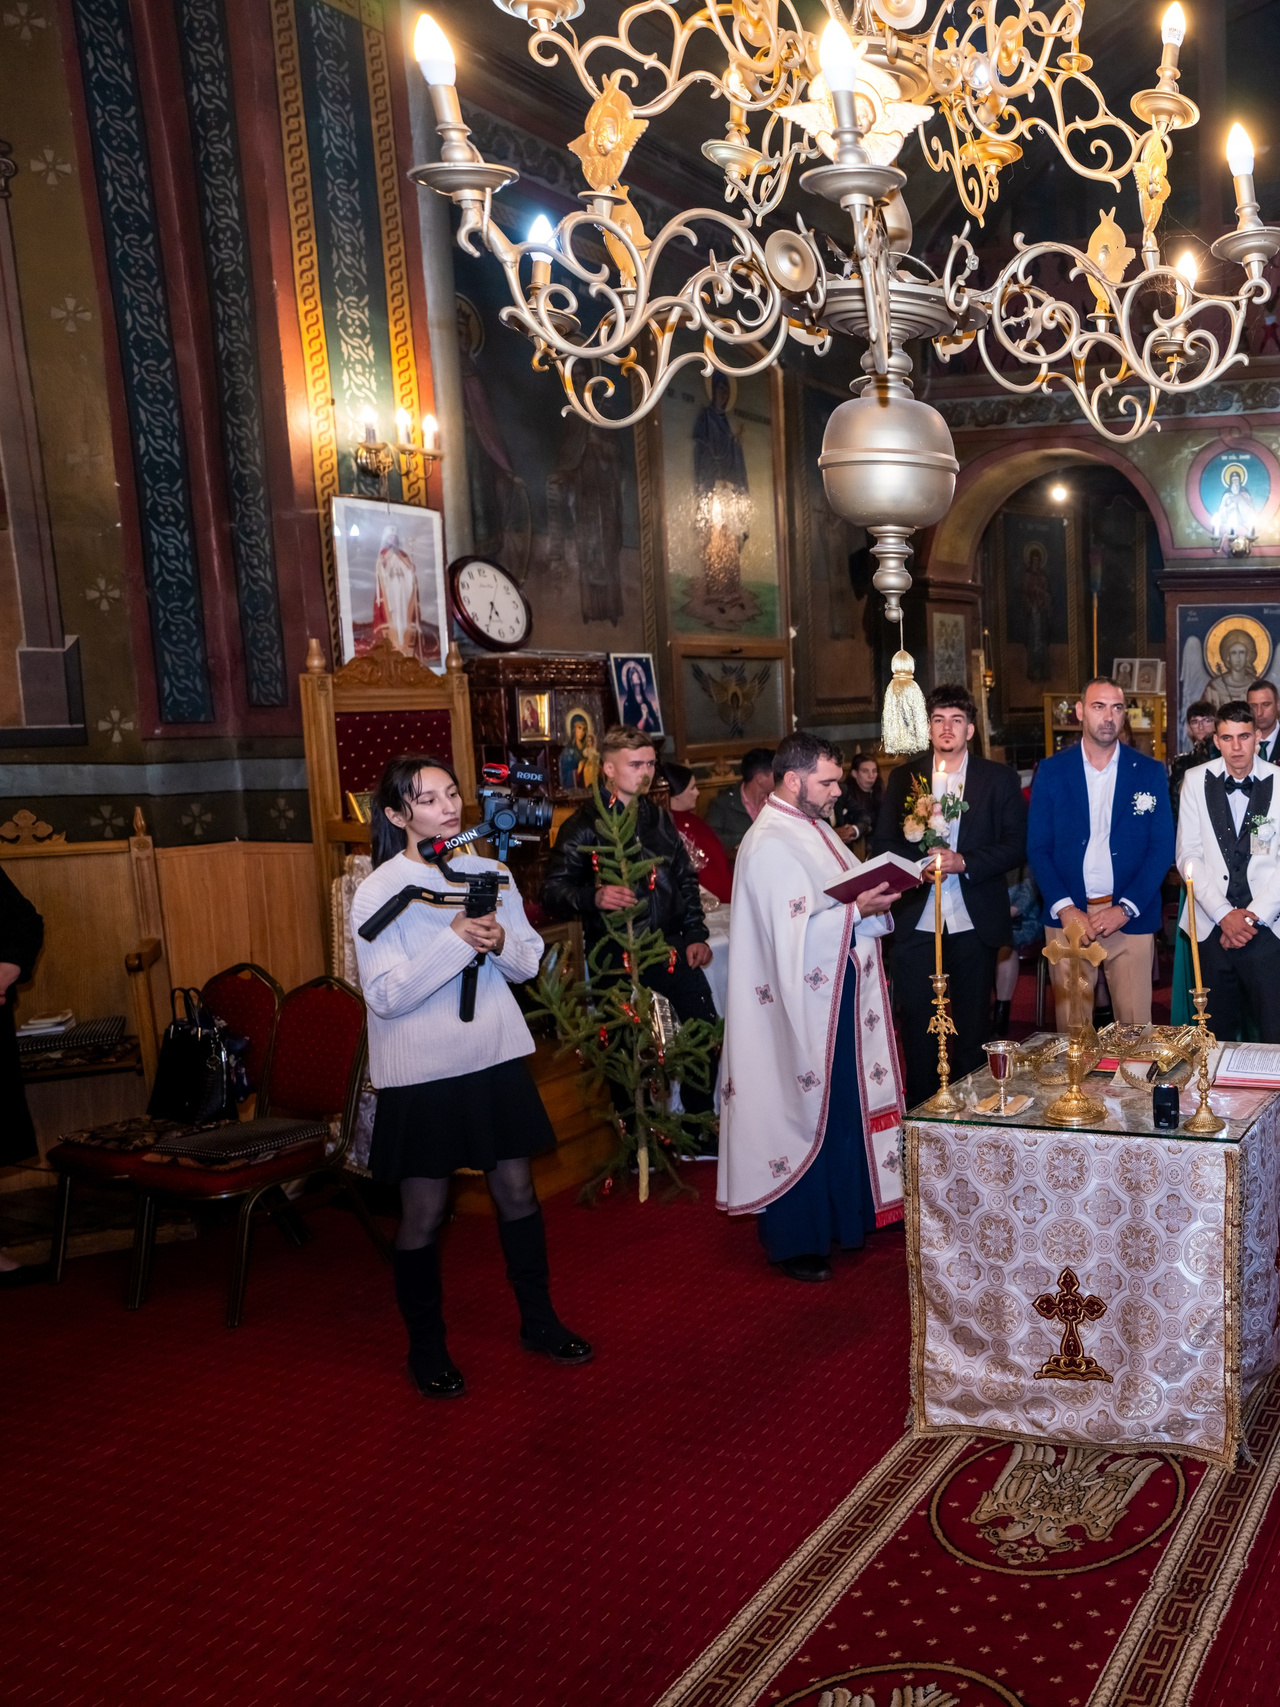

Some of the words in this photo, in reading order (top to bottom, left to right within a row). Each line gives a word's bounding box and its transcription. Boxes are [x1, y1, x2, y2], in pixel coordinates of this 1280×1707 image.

[467, 571, 475, 581] 11
[477, 568, 487, 578] 12
[460, 581, 470, 590] 10
[503, 585, 511, 595] 2
[463, 596, 470, 606] 9
[512, 600, 519, 610] 3
[471, 612, 479, 622] 8
[515, 616, 520, 625] 4
[484, 624, 490, 633] 7
[498, 628, 505, 638] 6
[444, 829, 478, 850] RONIN
